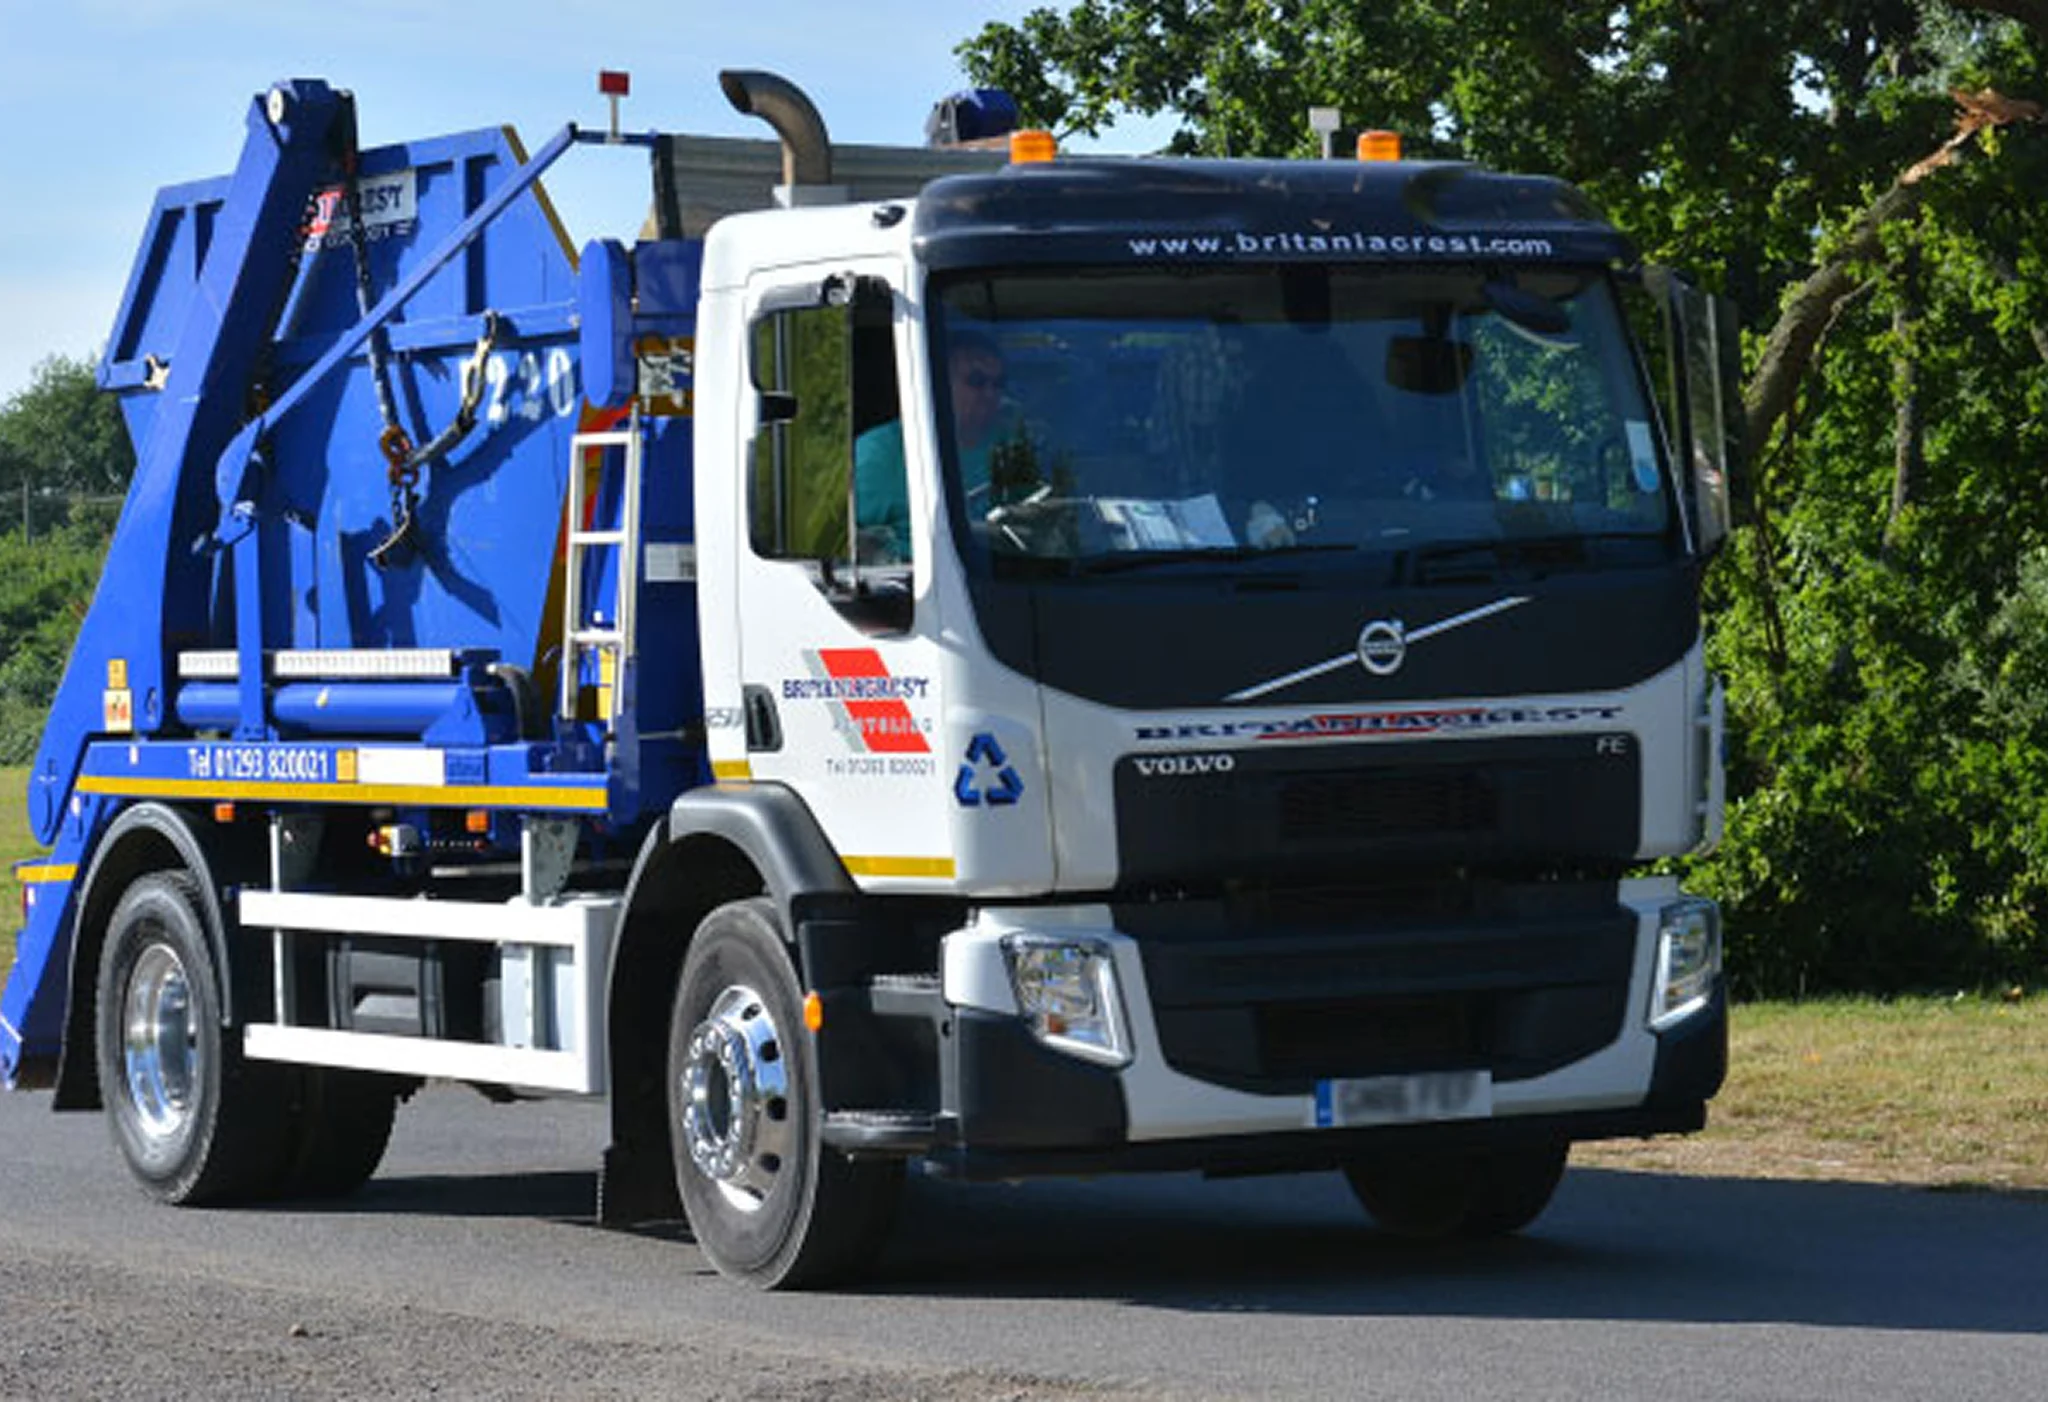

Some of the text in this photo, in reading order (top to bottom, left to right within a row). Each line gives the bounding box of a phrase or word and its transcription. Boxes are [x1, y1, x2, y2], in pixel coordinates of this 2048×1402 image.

[1128, 231, 1553, 256] www.britaniacrest.com
[1595, 735, 1629, 754] FE
[188, 745, 328, 780] Tel 01293 820021
[1133, 753, 1236, 776] VOLVO
